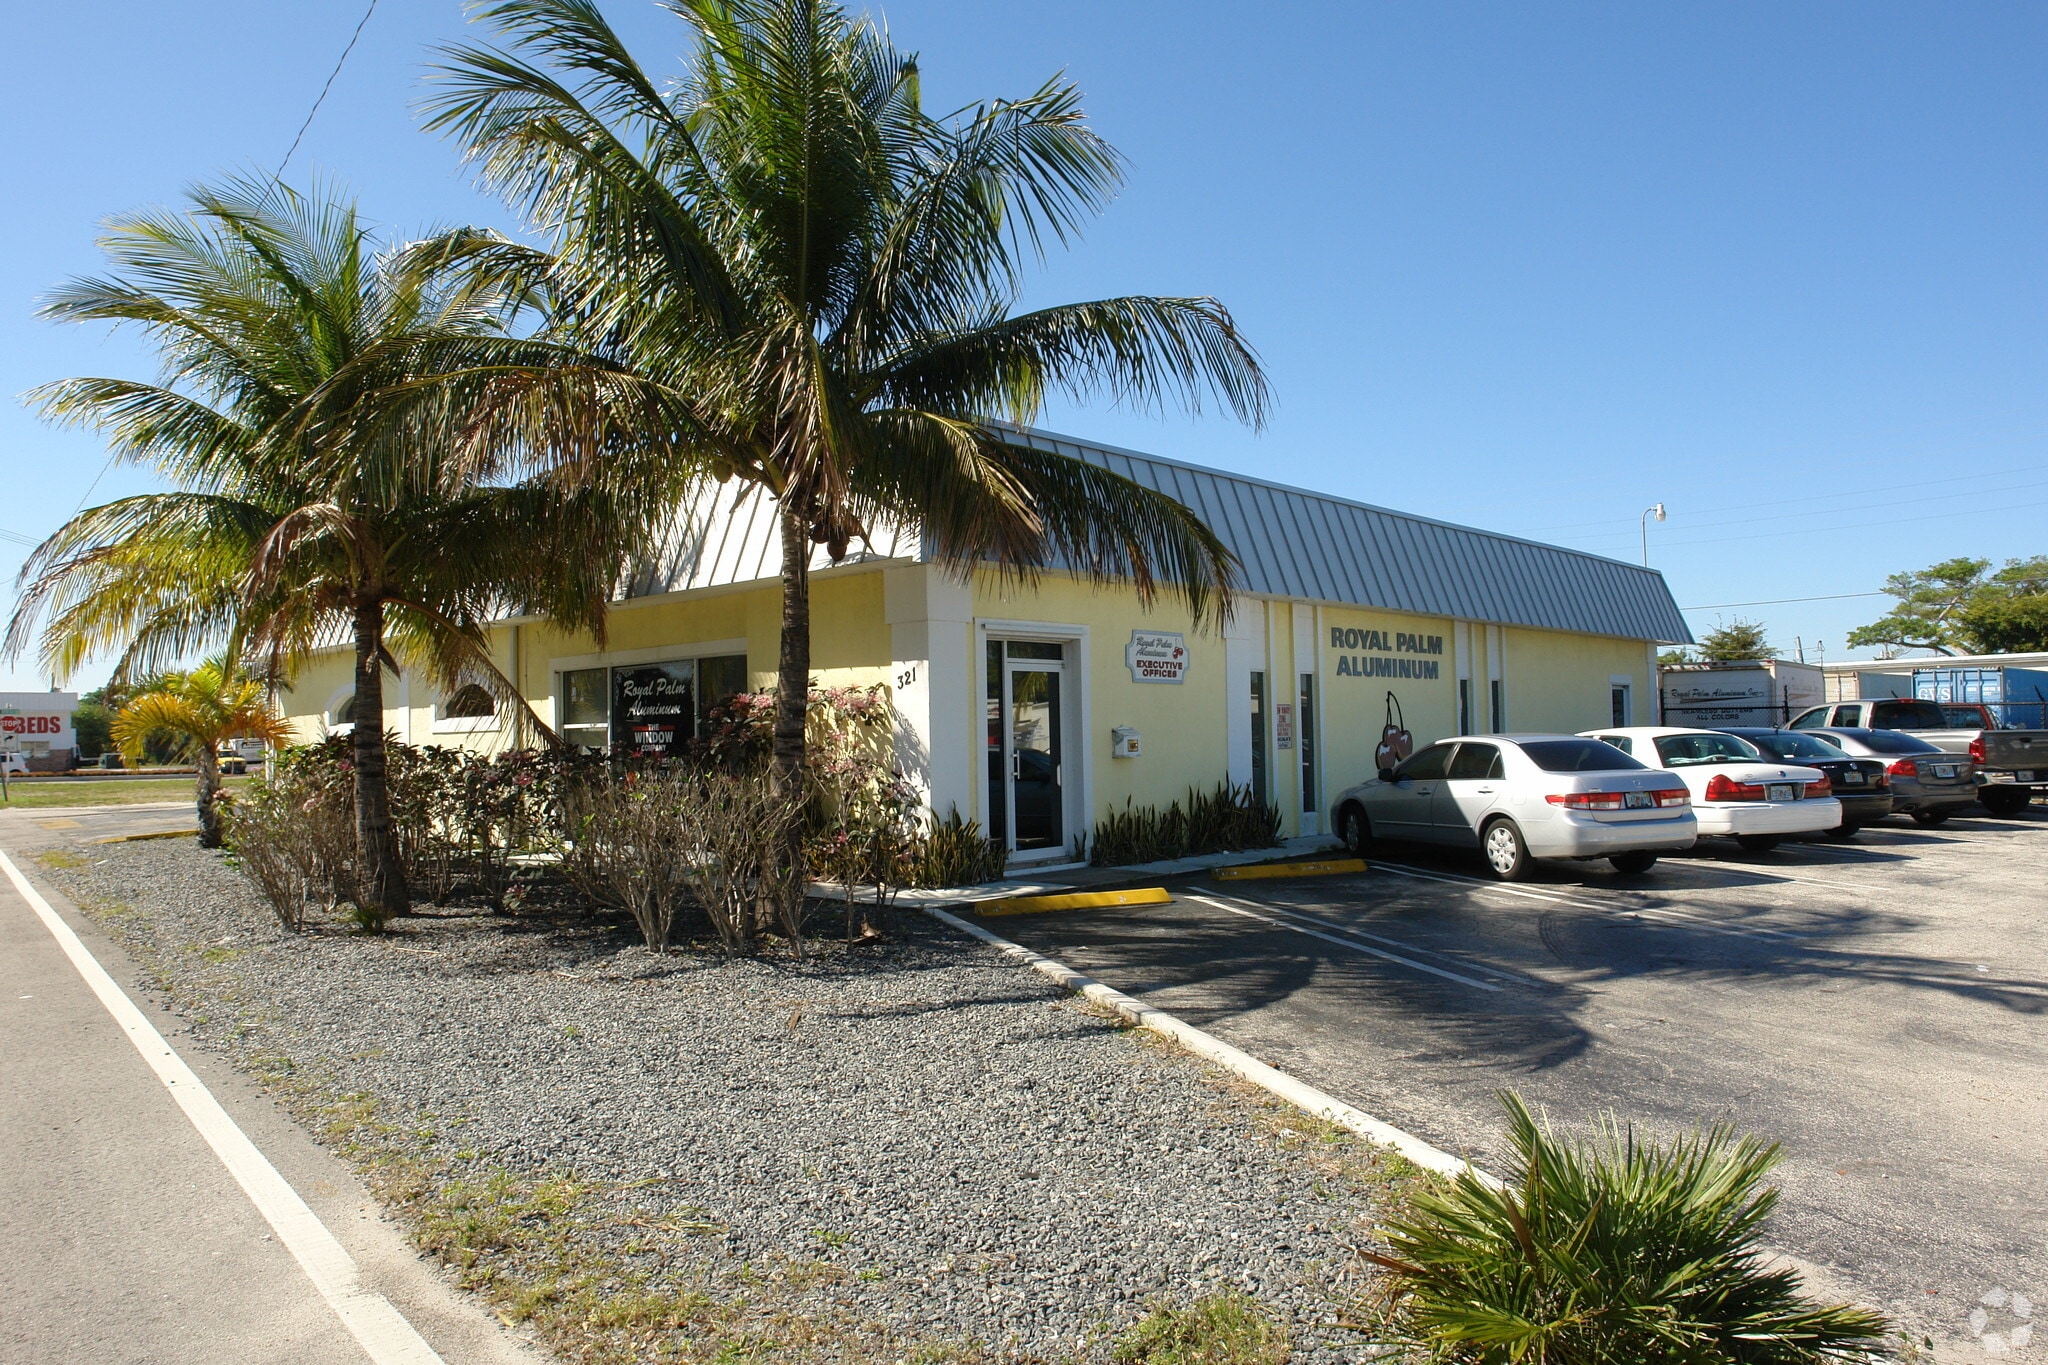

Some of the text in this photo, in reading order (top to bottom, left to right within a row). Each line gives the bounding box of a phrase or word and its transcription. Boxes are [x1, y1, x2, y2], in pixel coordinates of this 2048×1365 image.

[1331, 627, 1442, 655] ROYAL PALM
[1136, 660, 1183, 670] EXECUTIVE
[1336, 655, 1439, 679] ALUMINUM
[897, 666, 916, 690] 321
[1142, 668, 1177, 678] OFFICES
[623, 677, 686, 700] Royal Palm
[1692, 688, 1710, 697] Palm
[1712, 687, 1746, 697] Aluminum
[626, 700, 681, 718] Aluminum
[648, 723, 660, 731] THE
[634, 731, 674, 744] WINDOW
[641, 744, 667, 752] COMPANY
